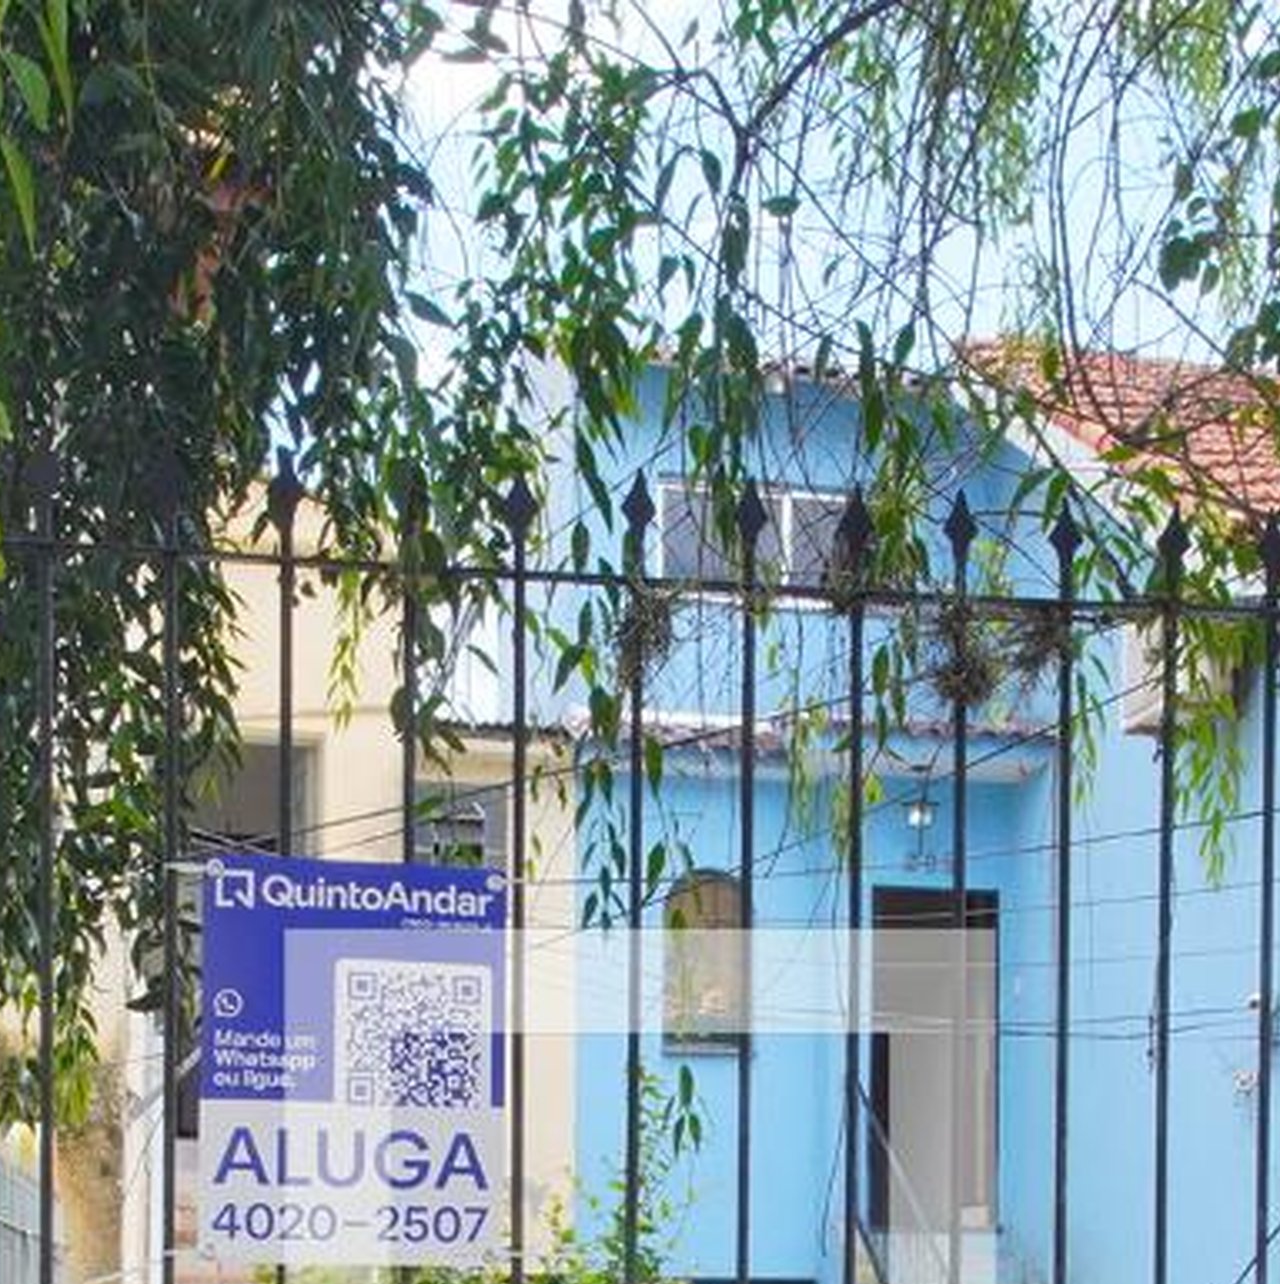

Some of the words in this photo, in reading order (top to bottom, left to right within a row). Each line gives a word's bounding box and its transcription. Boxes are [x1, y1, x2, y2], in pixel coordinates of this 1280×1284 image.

[261, 874, 494, 917] QuintoAndar
[214, 1029, 282, 1048] Mande
[213, 1071, 240, 1087] ou
[212, 1126, 490, 1191] ALUGA
[211, 1202, 490, 1244] 4020-2507
